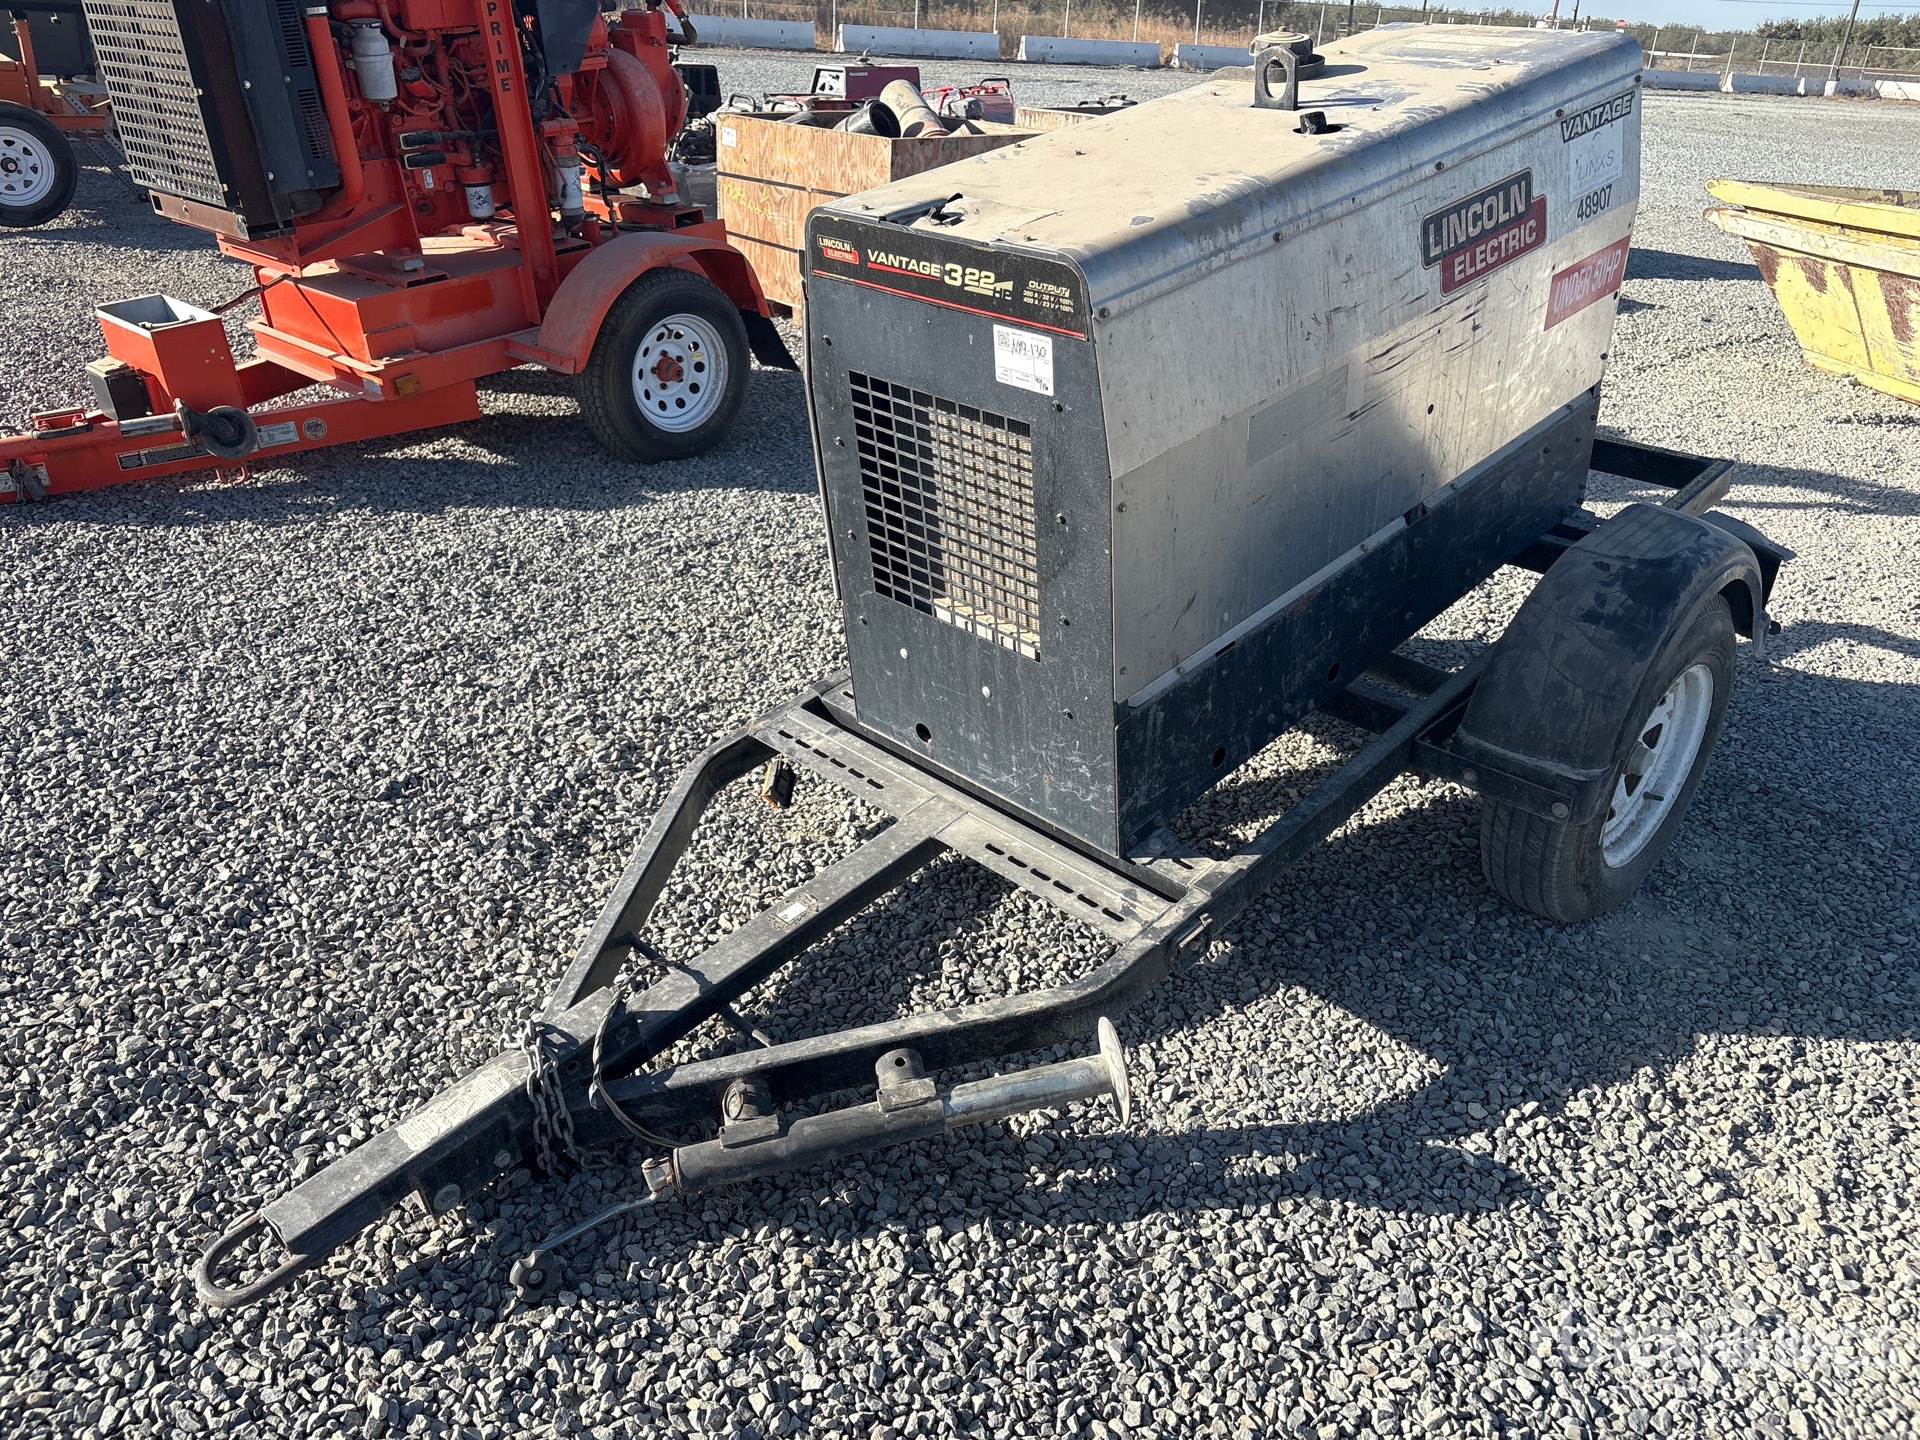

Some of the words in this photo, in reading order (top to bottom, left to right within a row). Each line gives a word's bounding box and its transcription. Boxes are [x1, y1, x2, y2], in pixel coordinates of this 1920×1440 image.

[486, 2, 512, 92] PRIME
[1561, 92, 1633, 142] VANTAGE
[1428, 179, 1526, 258] LINCOLN
[1577, 183, 1613, 222] 48907
[819, 237, 851, 252] LINCOLN
[827, 250, 855, 261] ELECTRIC
[867, 249, 942, 278] VANTAGE
[1454, 218, 1537, 282] ELECTRIC
[1028, 280, 1067, 295] OUTPUT
[1553, 264, 1592, 314] UNDER
